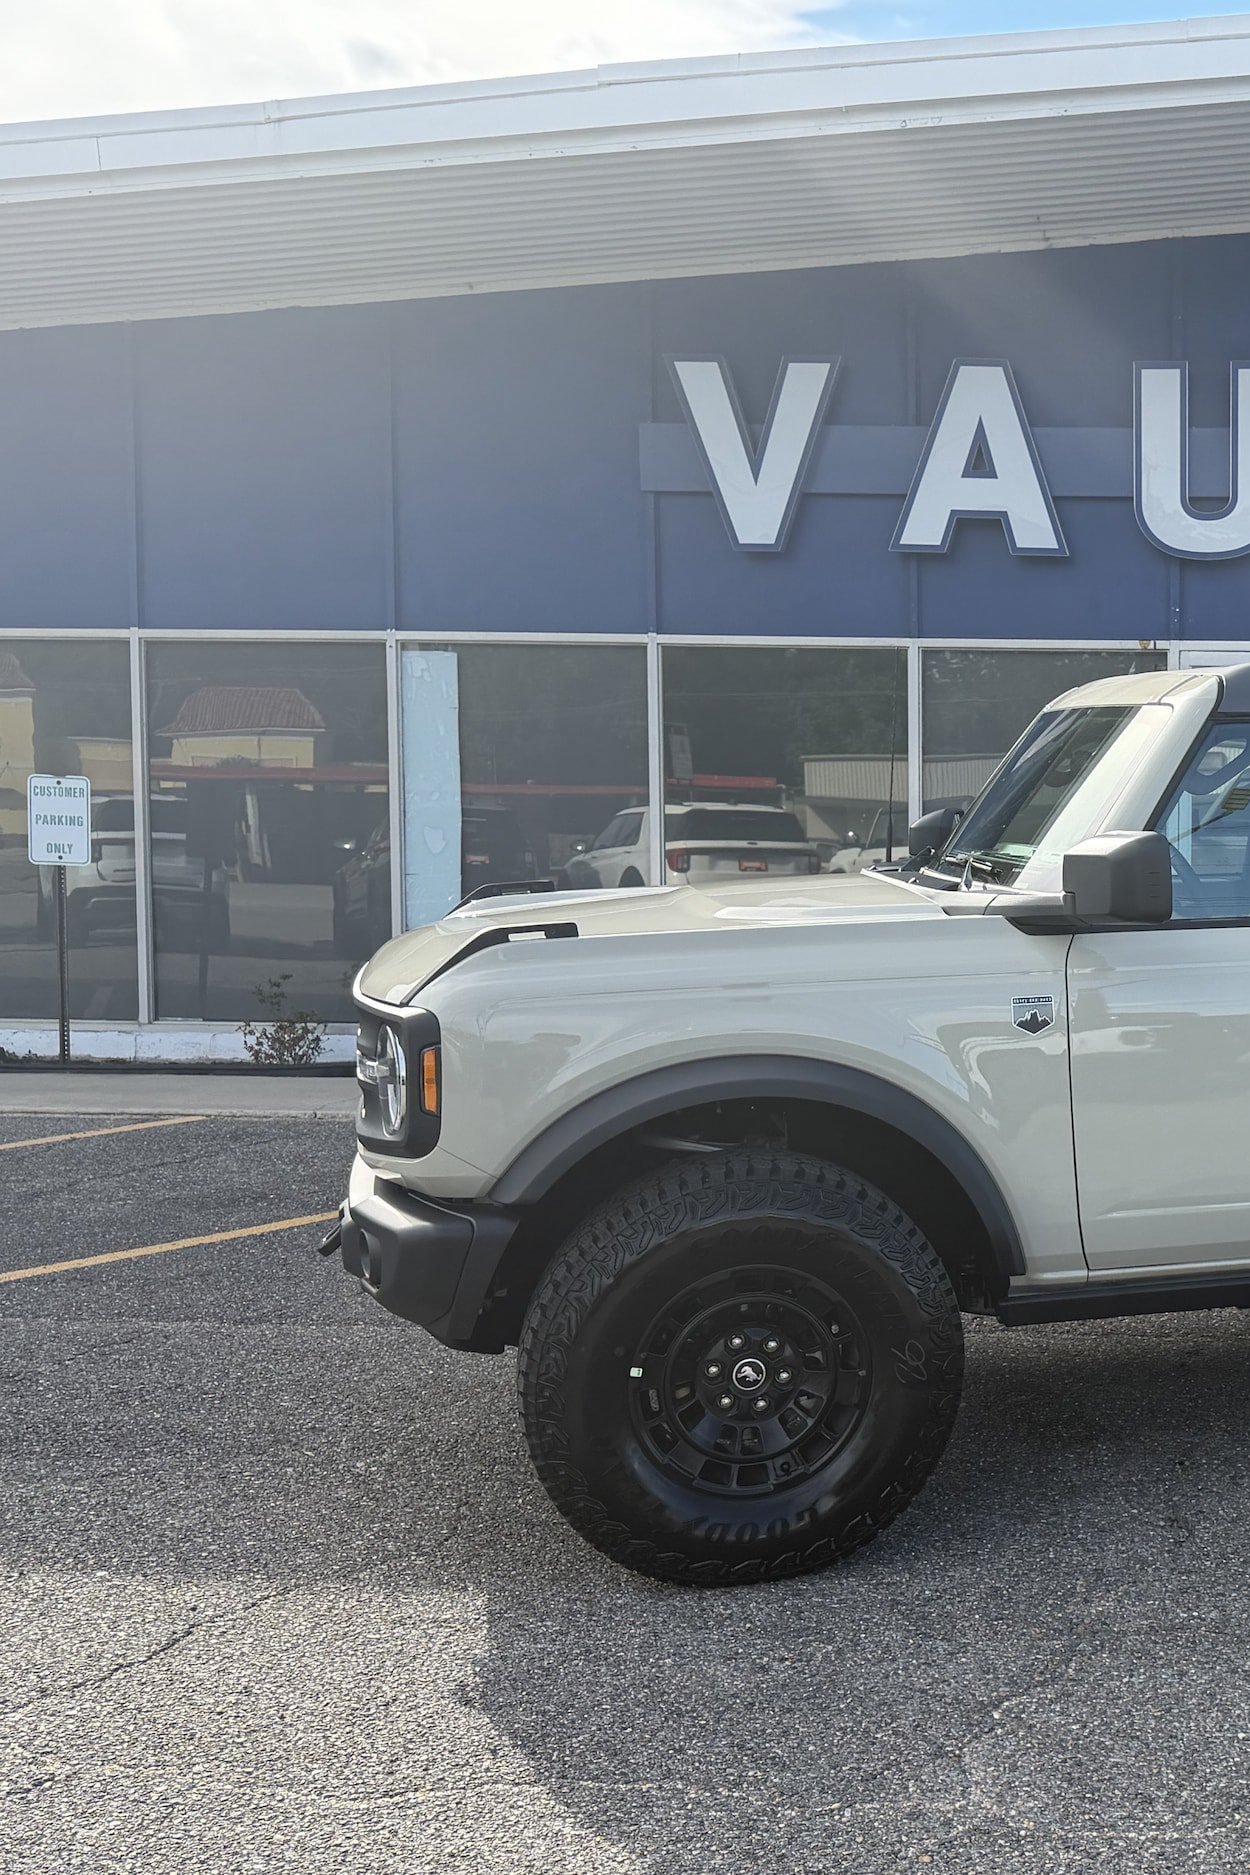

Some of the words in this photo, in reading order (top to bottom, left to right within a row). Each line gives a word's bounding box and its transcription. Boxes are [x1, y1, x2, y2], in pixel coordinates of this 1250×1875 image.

[33, 785, 85, 798] CUSTOMER
[35, 813, 84, 827] PARKING
[46, 842, 74, 855] ONLY
